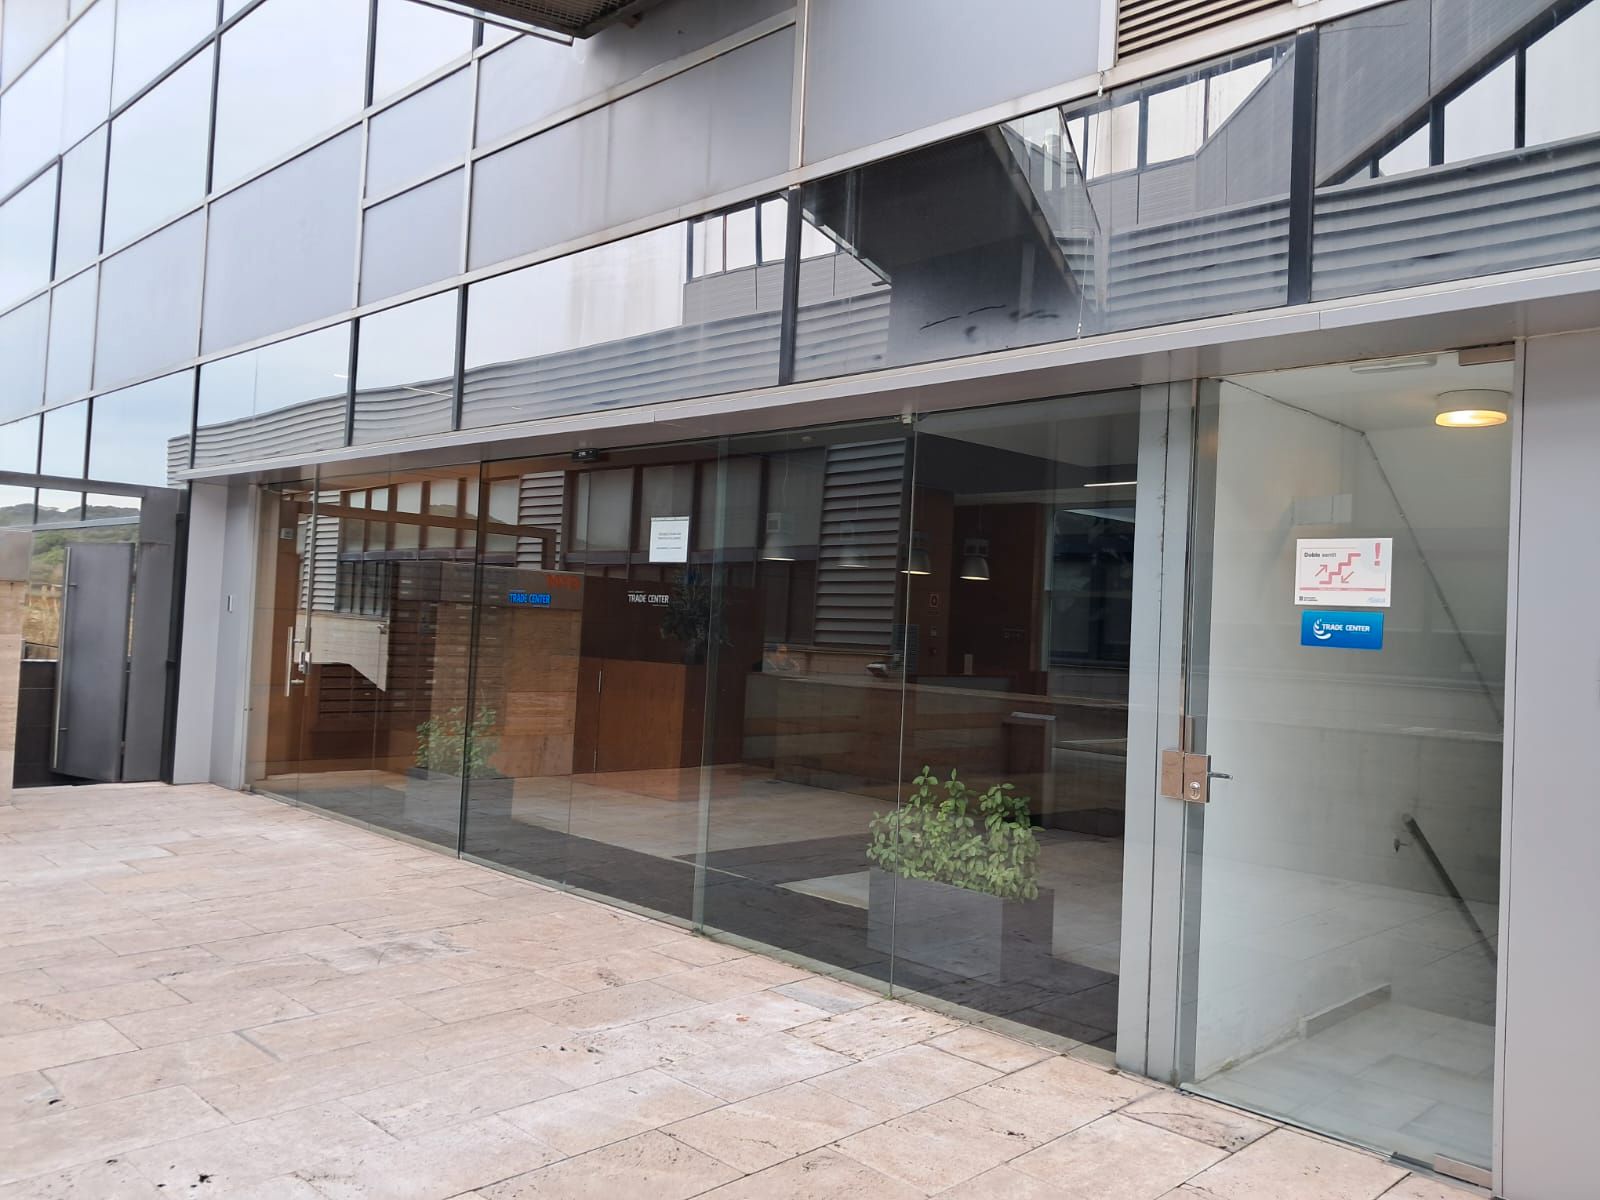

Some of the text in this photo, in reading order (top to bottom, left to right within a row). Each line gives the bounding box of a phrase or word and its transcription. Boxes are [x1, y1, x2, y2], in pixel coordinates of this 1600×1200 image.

[508, 593, 550, 604] TRADE CENTER
[628, 593, 670, 604] TRADE CENTER
[1321, 623, 1371, 633] TRADE CENTER
